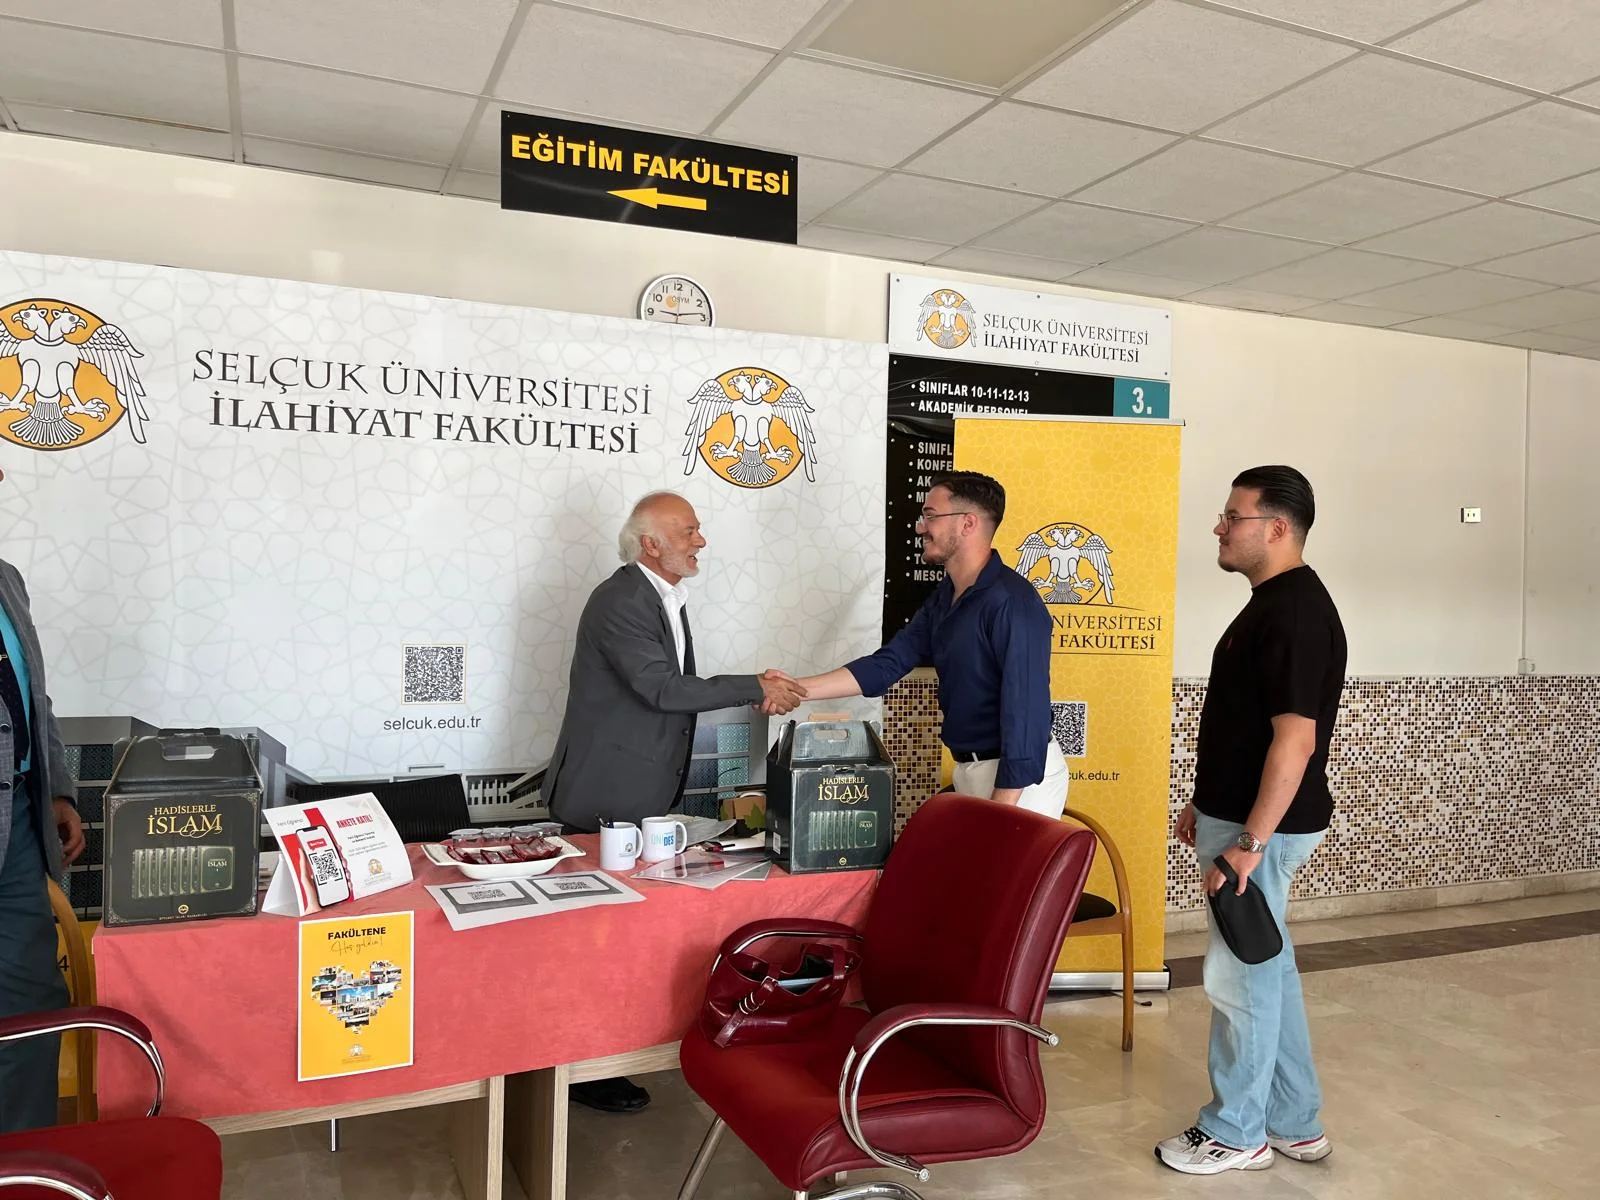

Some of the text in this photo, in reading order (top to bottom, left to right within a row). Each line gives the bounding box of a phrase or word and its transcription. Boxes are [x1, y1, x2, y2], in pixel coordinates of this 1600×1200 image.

[511, 132, 789, 196] EĞİTİM FAKÜLTESİ
[662, 285, 668, 294] 11
[673, 283, 683, 292] 12
[652, 293, 663, 303] 10
[696, 298, 703, 308] 2
[647, 307, 654, 316] 9
[701, 314, 706, 322] 3
[983, 313, 1149, 346] SELÇUK ÜNİVERSİTESİ
[983, 333, 1140, 363] İLAHİYAT FAKÜLTESİ
[192, 349, 653, 416] SELÇUK ÜNİVERSİTESİ
[919, 381, 1030, 402] SINIFLAR 10-11-12-13
[918, 400, 975, 414] AKADEMİK
[1132, 387, 1153, 414] 3.
[208, 390, 640, 455] İLAHİYAT FAKÜLTESİ
[1059, 632, 1155, 650] FAKÜLTESİ
[383, 715, 481, 731] selcuk.edu.tr
[823, 776, 865, 785] HADİSLERLE
[818, 783, 869, 805] İSLAM
[154, 804, 217, 816] HADİSLERLE
[147, 813, 223, 838] İSLAM
[327, 926, 386, 940] FAKÜLTENE
